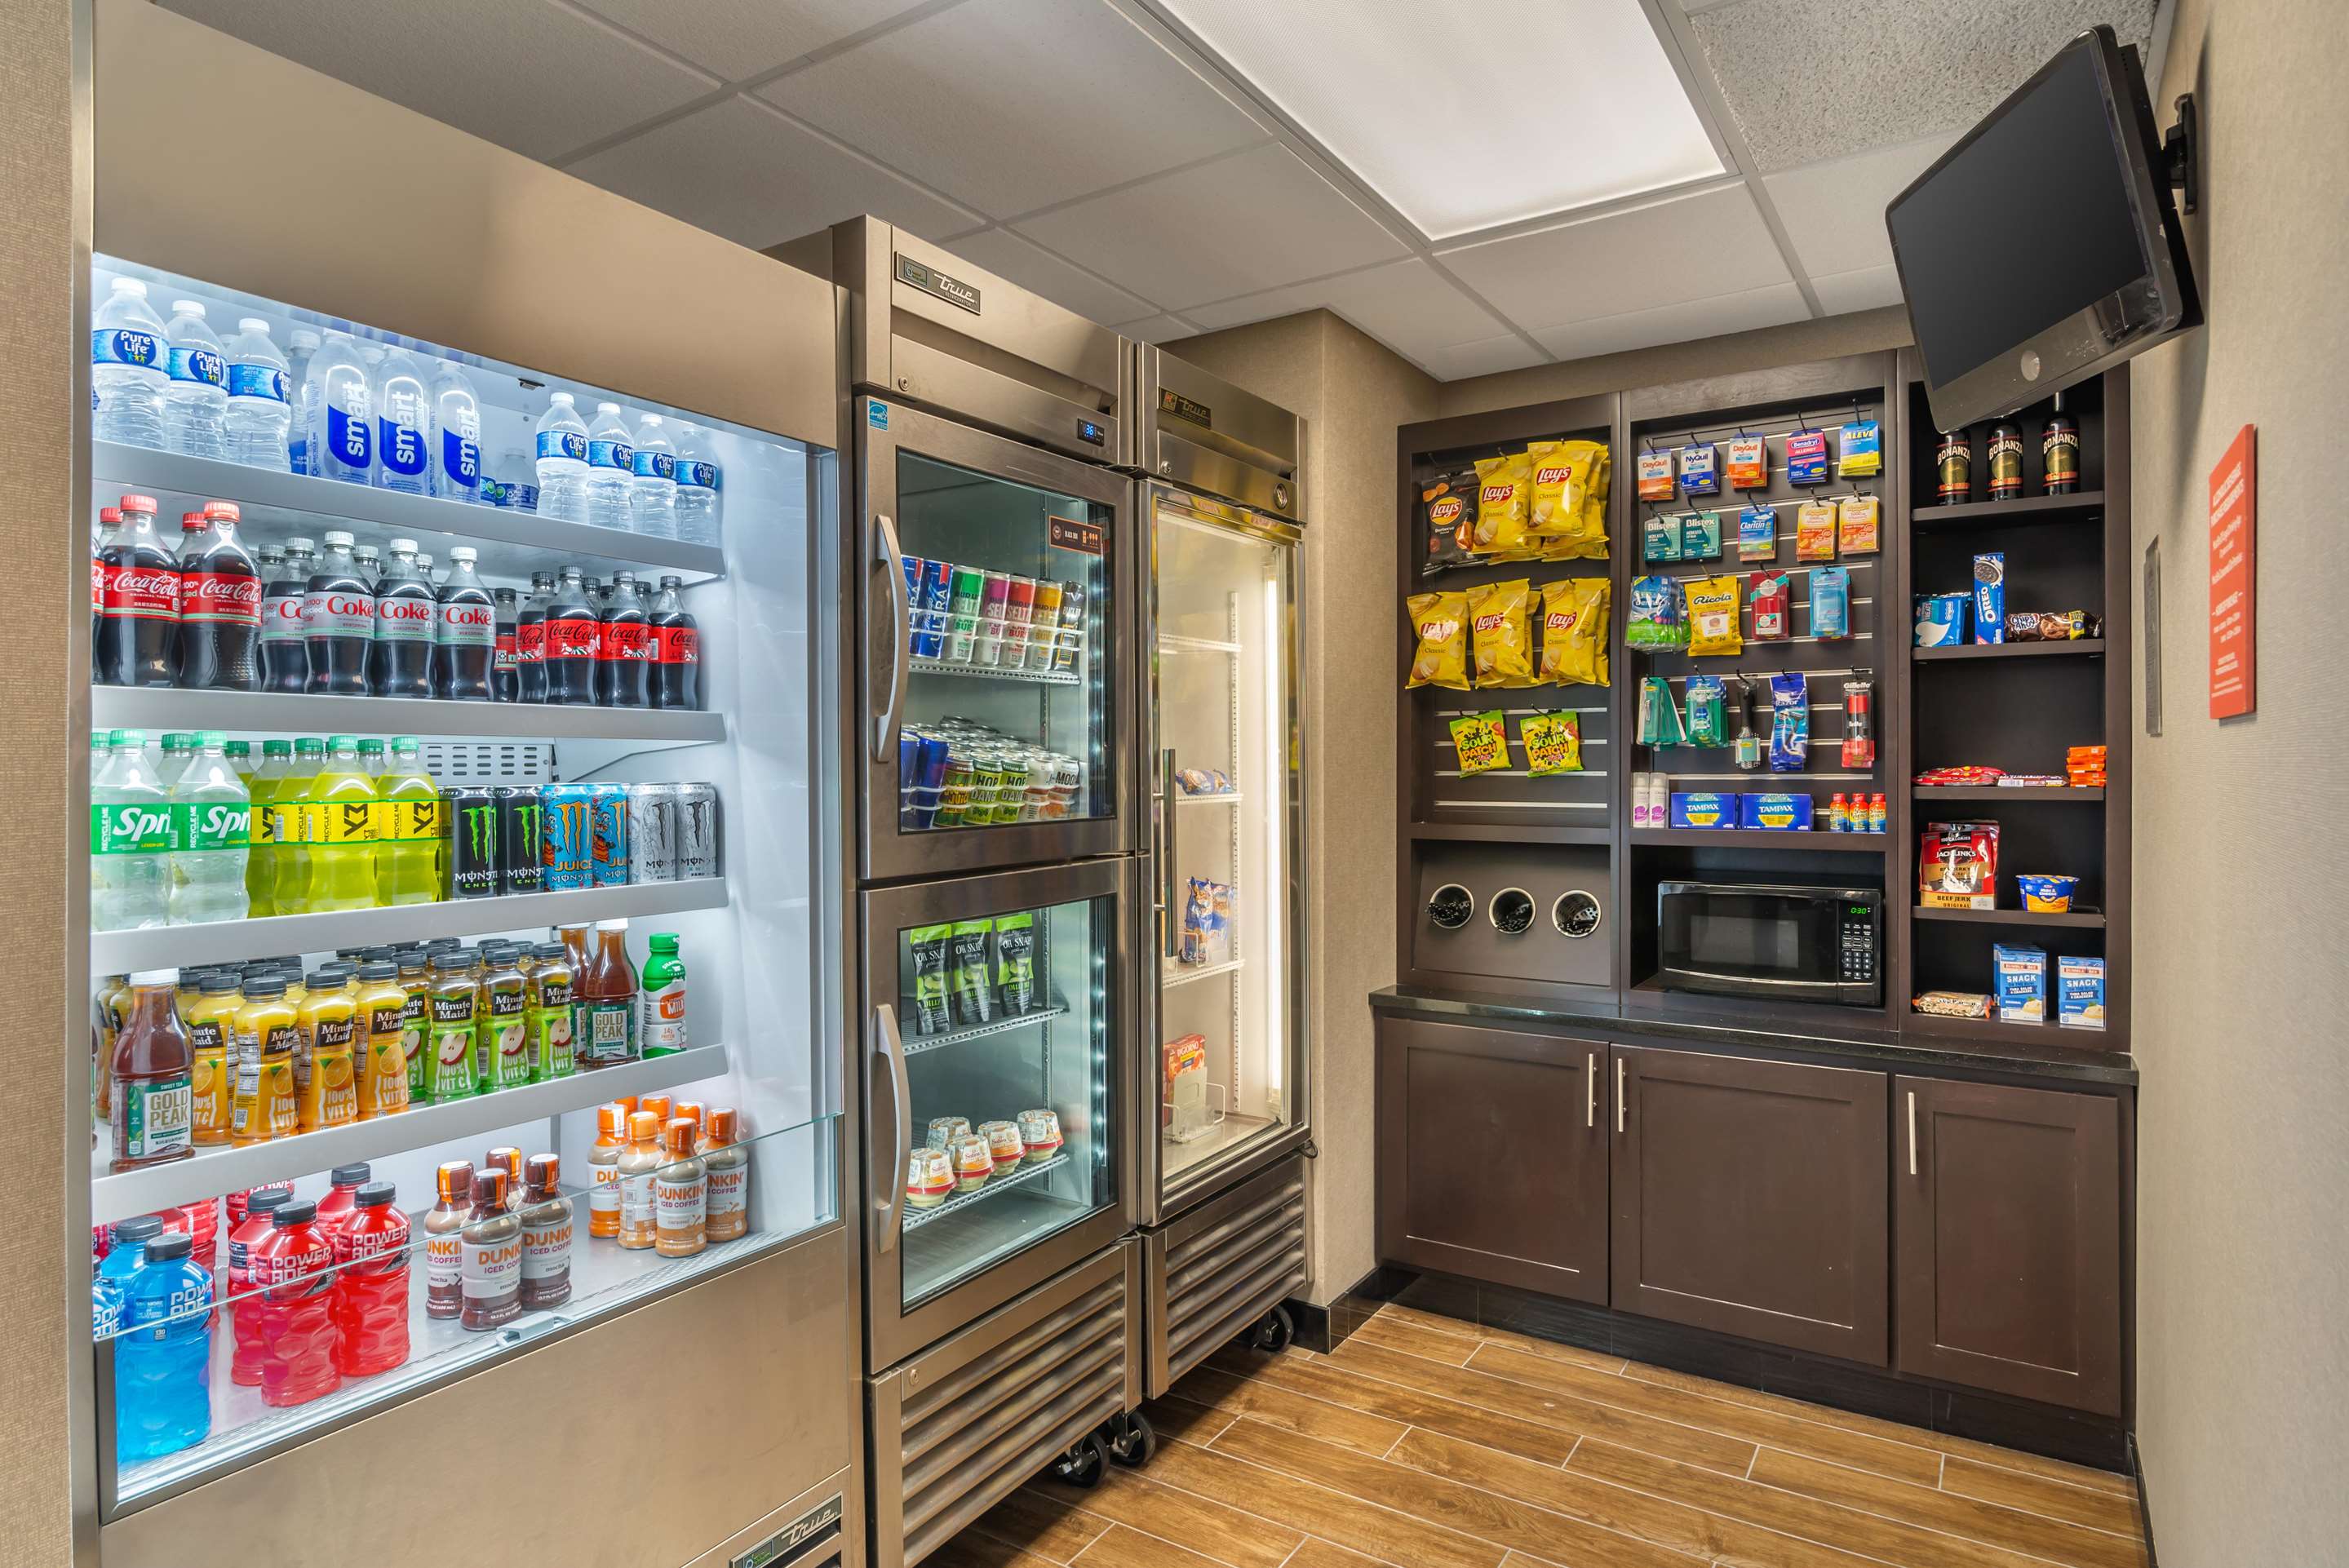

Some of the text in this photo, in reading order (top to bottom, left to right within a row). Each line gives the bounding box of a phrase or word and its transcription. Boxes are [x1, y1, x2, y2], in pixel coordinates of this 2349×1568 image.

[121, 331, 151, 345] Pure
[123, 341, 149, 354] Life
[196, 352, 221, 365] Pure
[199, 362, 219, 374] Life
[343, 381, 365, 457] smart
[392, 392, 415, 464] smart
[1846, 430, 1874, 439] ALEVE
[457, 405, 475, 477] smart
[567, 433, 584, 445] Pure
[1793, 439, 1818, 448] Benadryl
[2044, 433, 2079, 454] BONANZA
[1733, 445, 1757, 453] DayQuil
[1937, 445, 1970, 466] BONANZA
[1988, 441, 2023, 461] BONANZA
[657, 454, 673, 463] Pure
[1642, 459, 1667, 468] DayQuil
[1686, 454, 1708, 463] NyQuil
[1648, 522, 1677, 531] Blistex
[1686, 518, 1715, 527] Blistex
[1740, 521, 1765, 529] Claritin
[113, 571, 179, 597] Coca-Cola
[200, 578, 259, 602] Coca-Cola
[1693, 594, 1732, 605] Ricola
[1981, 587, 1997, 623] OREO
[279, 600, 304, 620] Co
[327, 596, 374, 618] Coke
[380, 600, 430, 621] Coke
[446, 606, 492, 626] Coke
[548, 622, 596, 640] Coca-Cola
[1462, 734, 1493, 750] SOUR
[1532, 734, 1565, 748] SOUR
[1462, 743, 1497, 761] PATCH
[1531, 742, 1569, 761] PATCH
[1686, 803, 1719, 812] TAMPAX
[1758, 804, 1793, 813] TAMPAX
[554, 860, 592, 872] JUICE
[495, 994, 526, 1004] Minute
[552, 994, 571, 1004] Maid
[436, 1001, 471, 1011] Minute
[500, 1003, 523, 1012] Maid
[440, 1009, 467, 1019] Maid
[596, 1012, 623, 1026] GOLD
[321, 1023, 353, 1034] Minute
[381, 1019, 404, 1031] Maid
[193, 1028, 216, 1037] nute
[326, 1032, 350, 1043] Maid
[596, 1025, 623, 1039] PEAK
[441, 1064, 465, 1077] 100%
[504, 1068, 519, 1080] VIT
[441, 1077, 465, 1091] VIT C
[150, 1090, 188, 1110] GOLD
[326, 1090, 353, 1102] 100%
[383, 1089, 397, 1102] VIT
[193, 1096, 211, 1109] 00%
[150, 1105, 188, 1127] PEAK
[327, 1106, 343, 1119] VIT
[707, 1172, 744, 1187] NKIN'
[658, 1182, 706, 1200] DUNKIN'
[661, 1199, 700, 1208] ICED COFFEE
[352, 1226, 408, 1247] POWER
[273, 1247, 331, 1269] POWER
[530, 1247, 549, 1256] ICED
[484, 1265, 504, 1274] ICED
